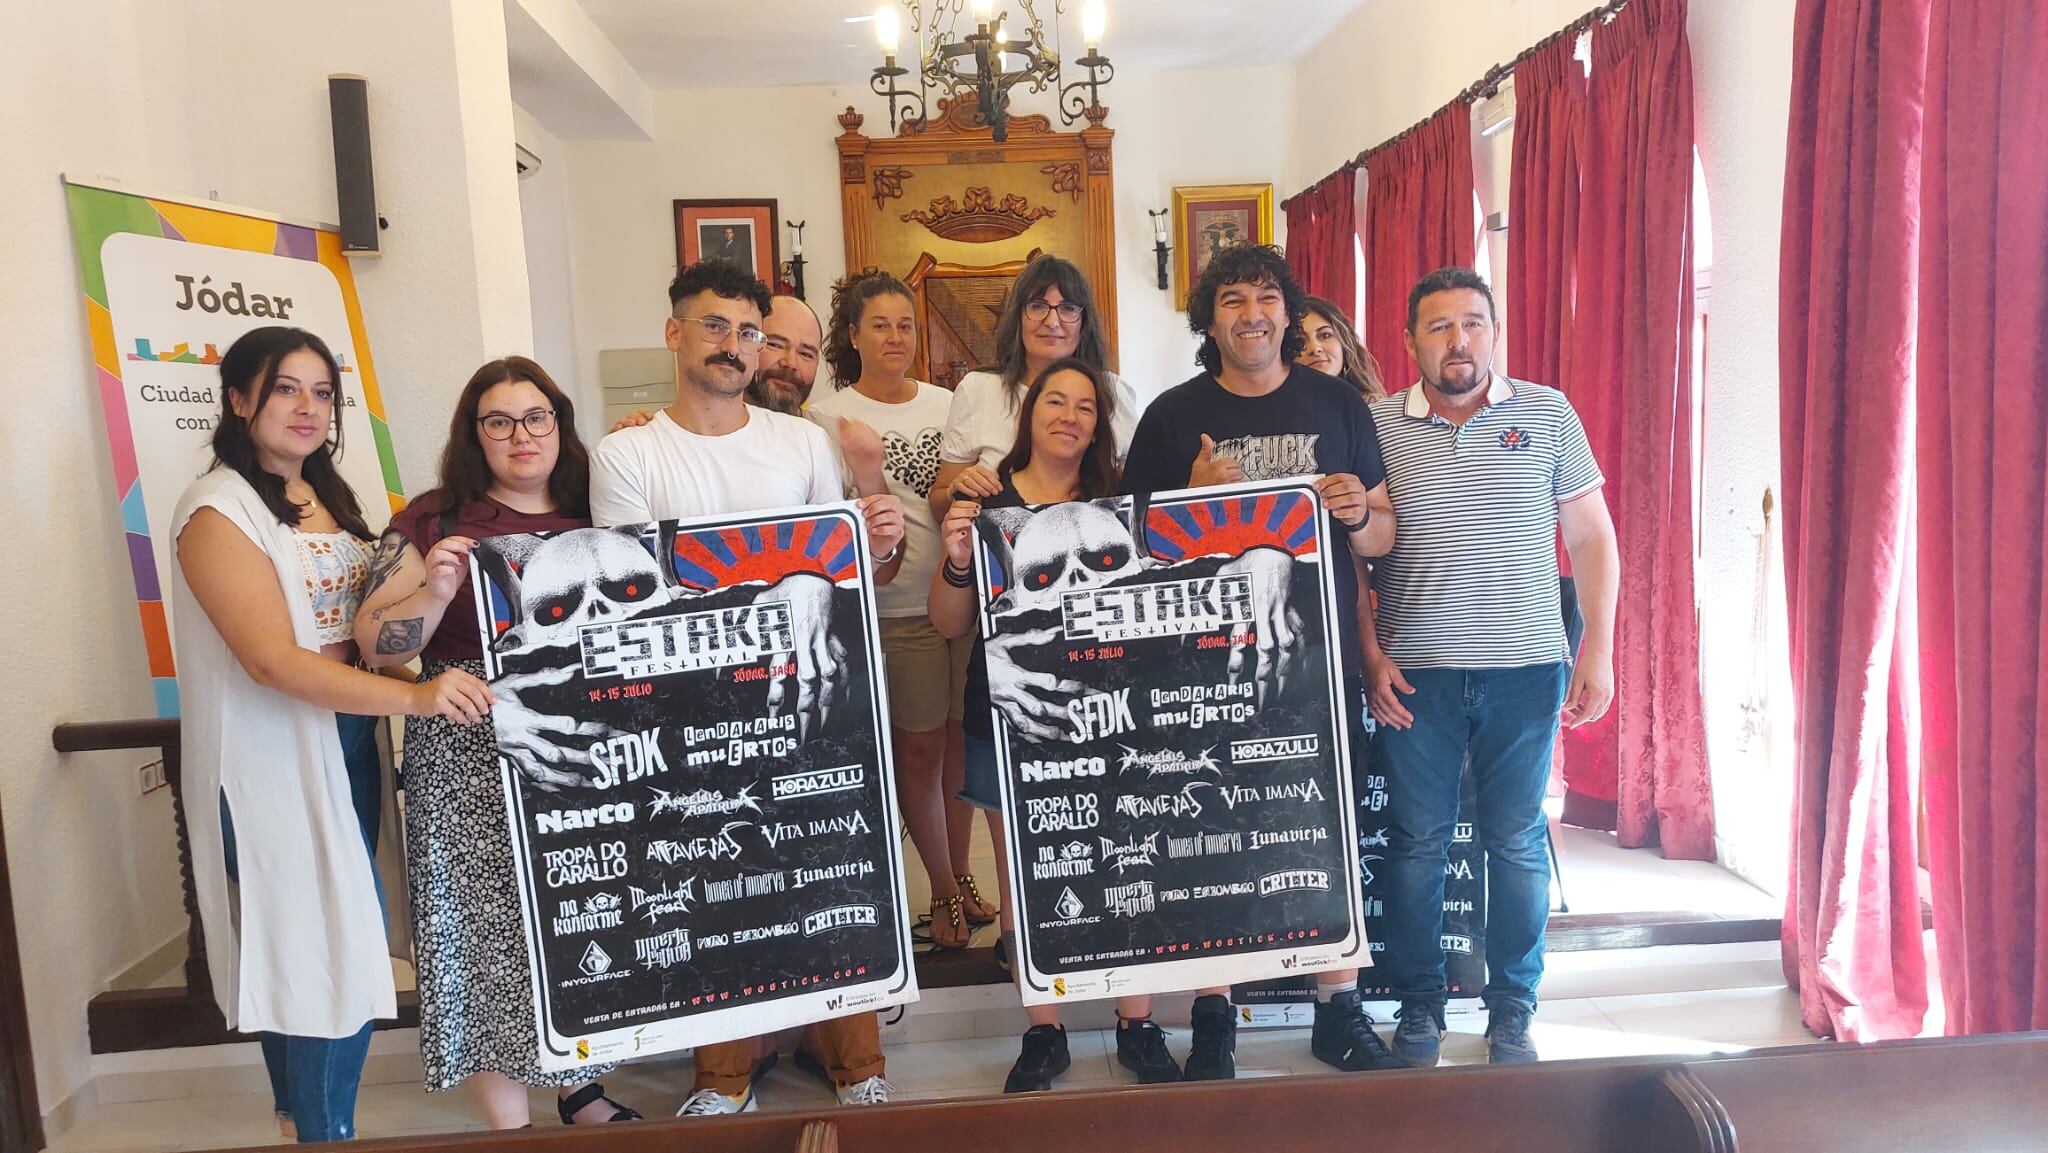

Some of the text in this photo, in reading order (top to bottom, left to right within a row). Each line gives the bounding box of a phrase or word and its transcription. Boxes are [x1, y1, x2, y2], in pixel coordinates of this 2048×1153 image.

[175, 274, 293, 320] Jódar
[140, 384, 215, 405] Ciudad
[176, 416, 212, 430] con
[1248, 433, 1320, 470] FUCK
[1063, 576, 1252, 637] ESTAKA
[582, 603, 793, 675] ESTAKA
[1105, 621, 1213, 639] FESTIVAL
[630, 652, 752, 675] FESTIVAL
[1067, 687, 1137, 744] SFDK
[589, 727, 668, 790] SFDK
[1231, 738, 1319, 760] HORAZULU
[772, 767, 864, 797] HORAZULU
[1219, 777, 1325, 810] VITA IMANA
[1026, 793, 1098, 815] TROPA DO
[759, 809, 872, 848] VITA IMANA
[1028, 809, 1099, 834] CARALLO
[543, 841, 626, 868] TROPA DO
[546, 857, 629, 888] CARALLO
[1260, 870, 1329, 895] CRITTER
[804, 905, 877, 935] CRITTER
[1442, 898, 1474, 915] vieja
